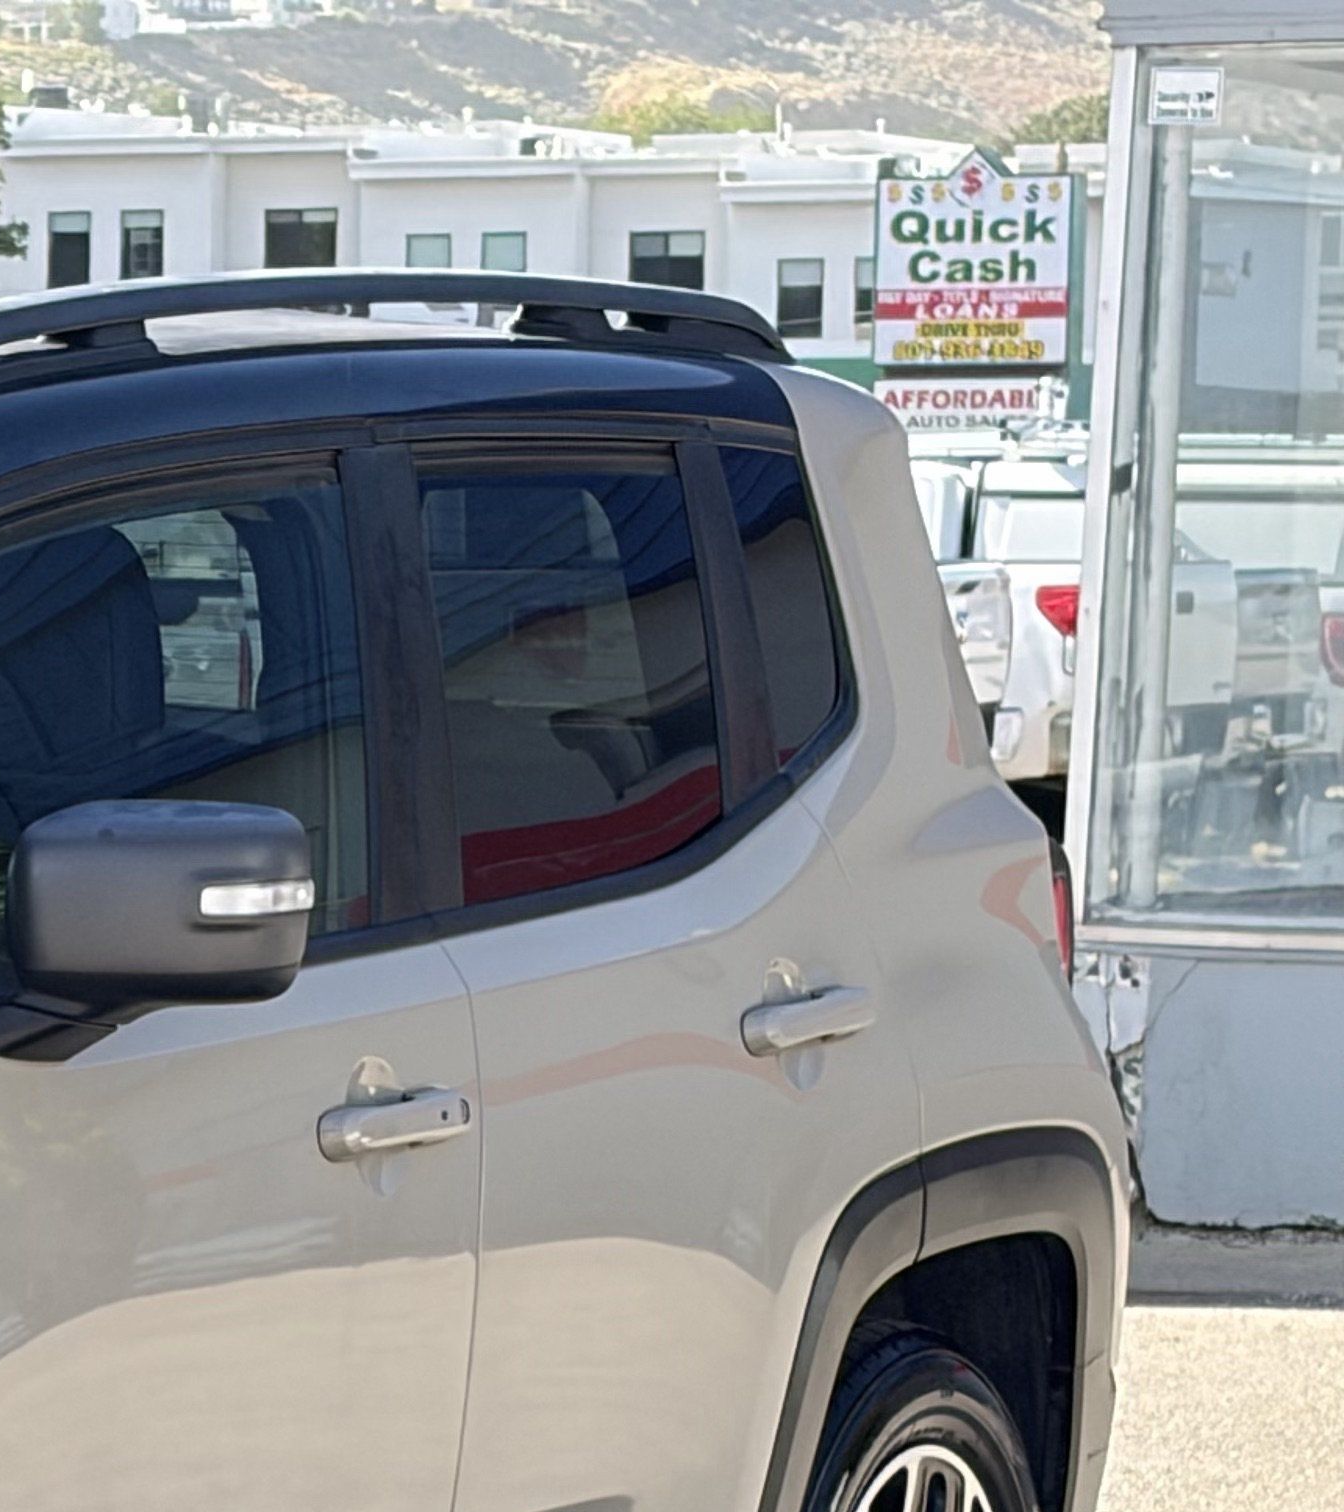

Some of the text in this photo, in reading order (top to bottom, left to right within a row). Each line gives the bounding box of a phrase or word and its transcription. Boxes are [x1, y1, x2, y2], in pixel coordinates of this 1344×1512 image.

[890, 209, 1056, 244] Quick
[909, 250, 1037, 283] Cash
[914, 303, 1019, 319] LOANS
[921, 323, 1020, 337] DRIVE THRU
[884, 388, 1035, 410] AFFORDABL
[906, 415, 960, 429] AUTO
